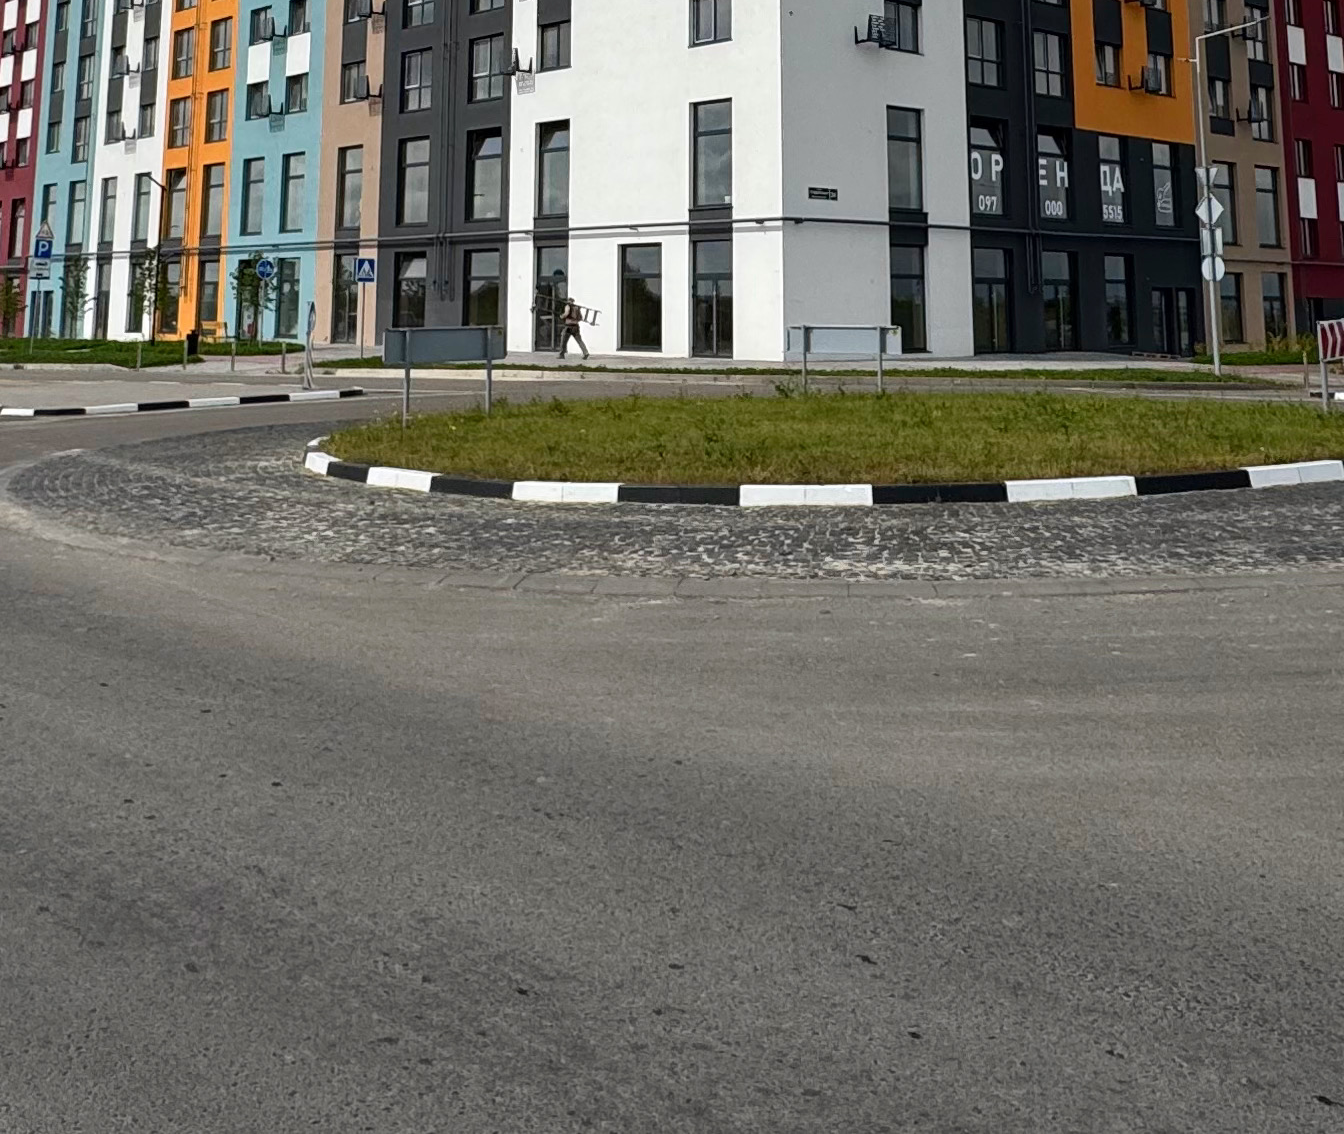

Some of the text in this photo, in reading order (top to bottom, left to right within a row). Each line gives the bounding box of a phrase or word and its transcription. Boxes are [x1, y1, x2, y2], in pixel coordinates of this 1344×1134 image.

[978, 194, 1123, 221] 097 000 5515
[38, 240, 49, 256] P
